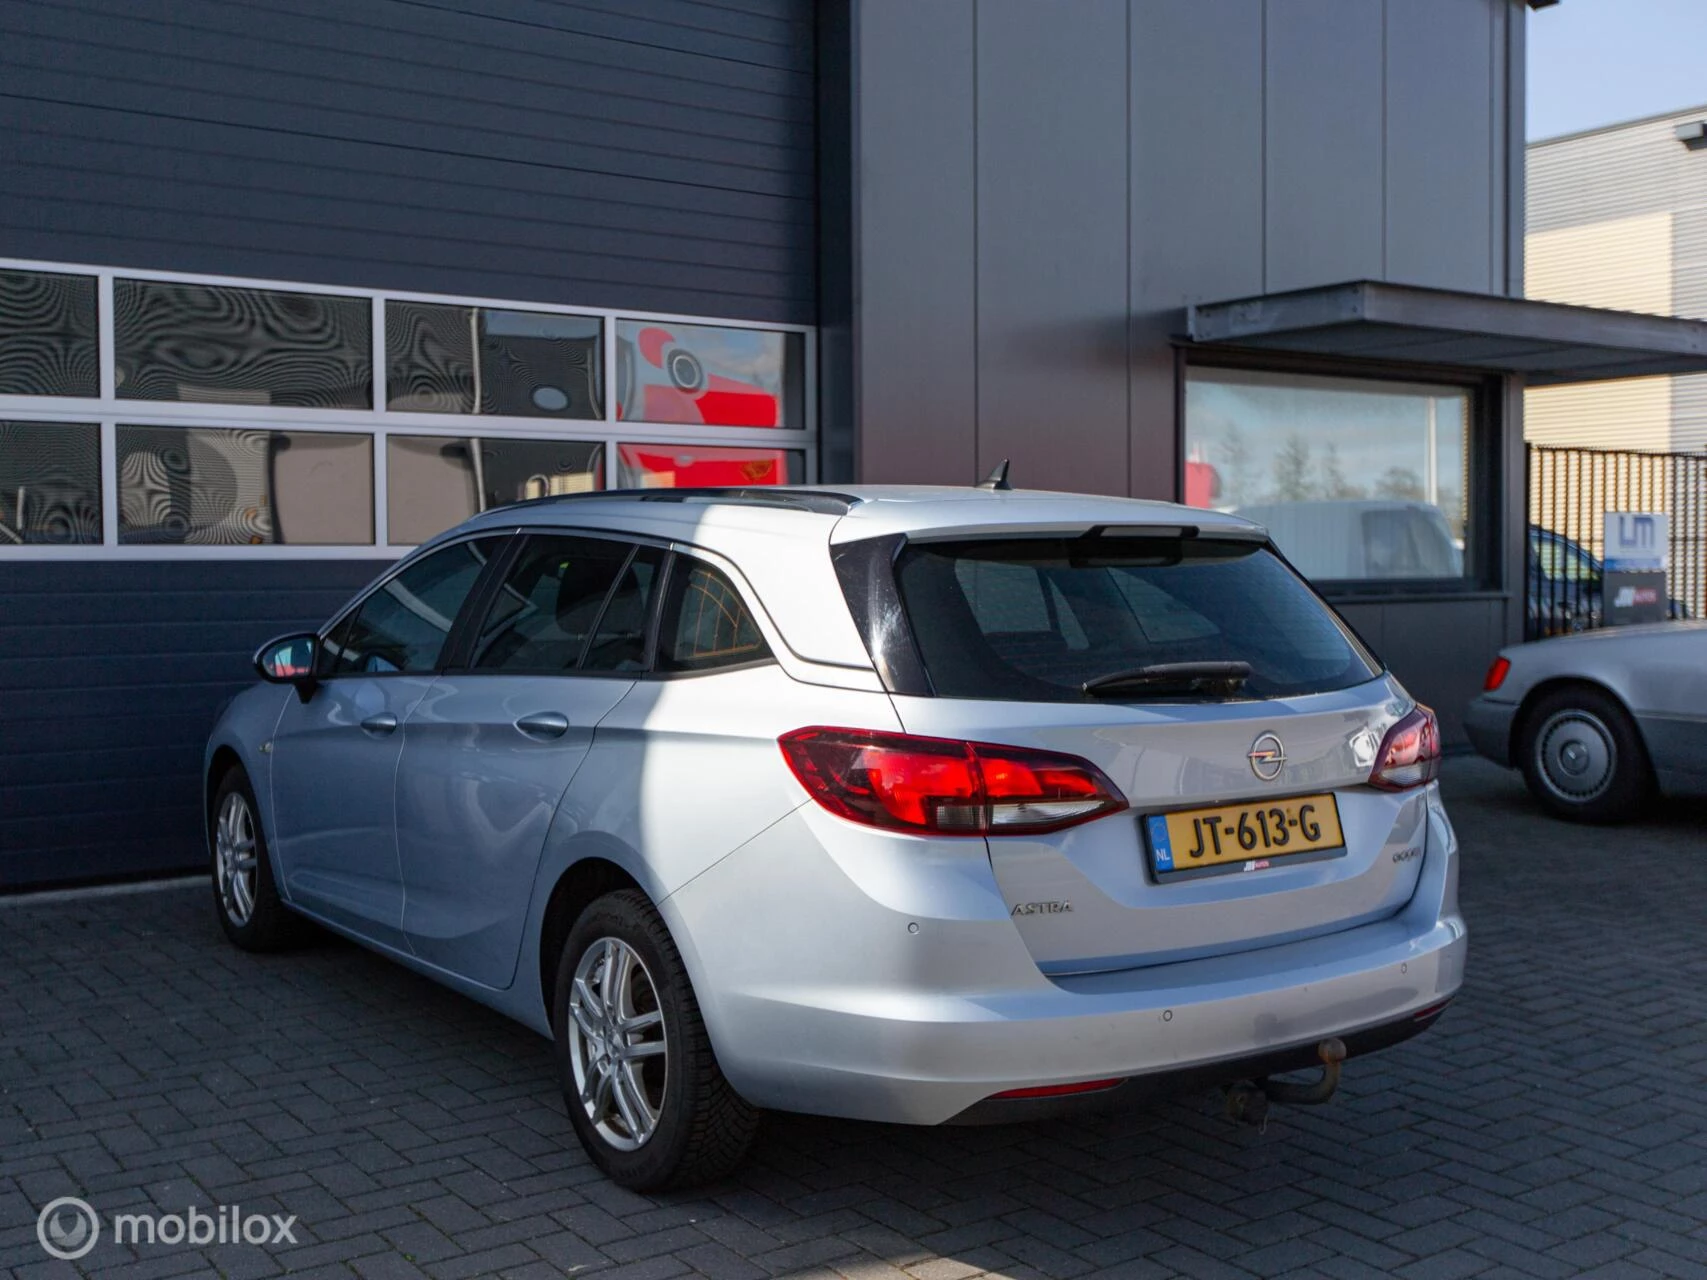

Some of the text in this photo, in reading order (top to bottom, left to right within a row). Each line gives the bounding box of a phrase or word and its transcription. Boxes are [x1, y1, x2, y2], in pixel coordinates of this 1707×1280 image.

[1155, 804, 1322, 861] NL JT-613-G
[1010, 900, 1074, 916] ASTRA
